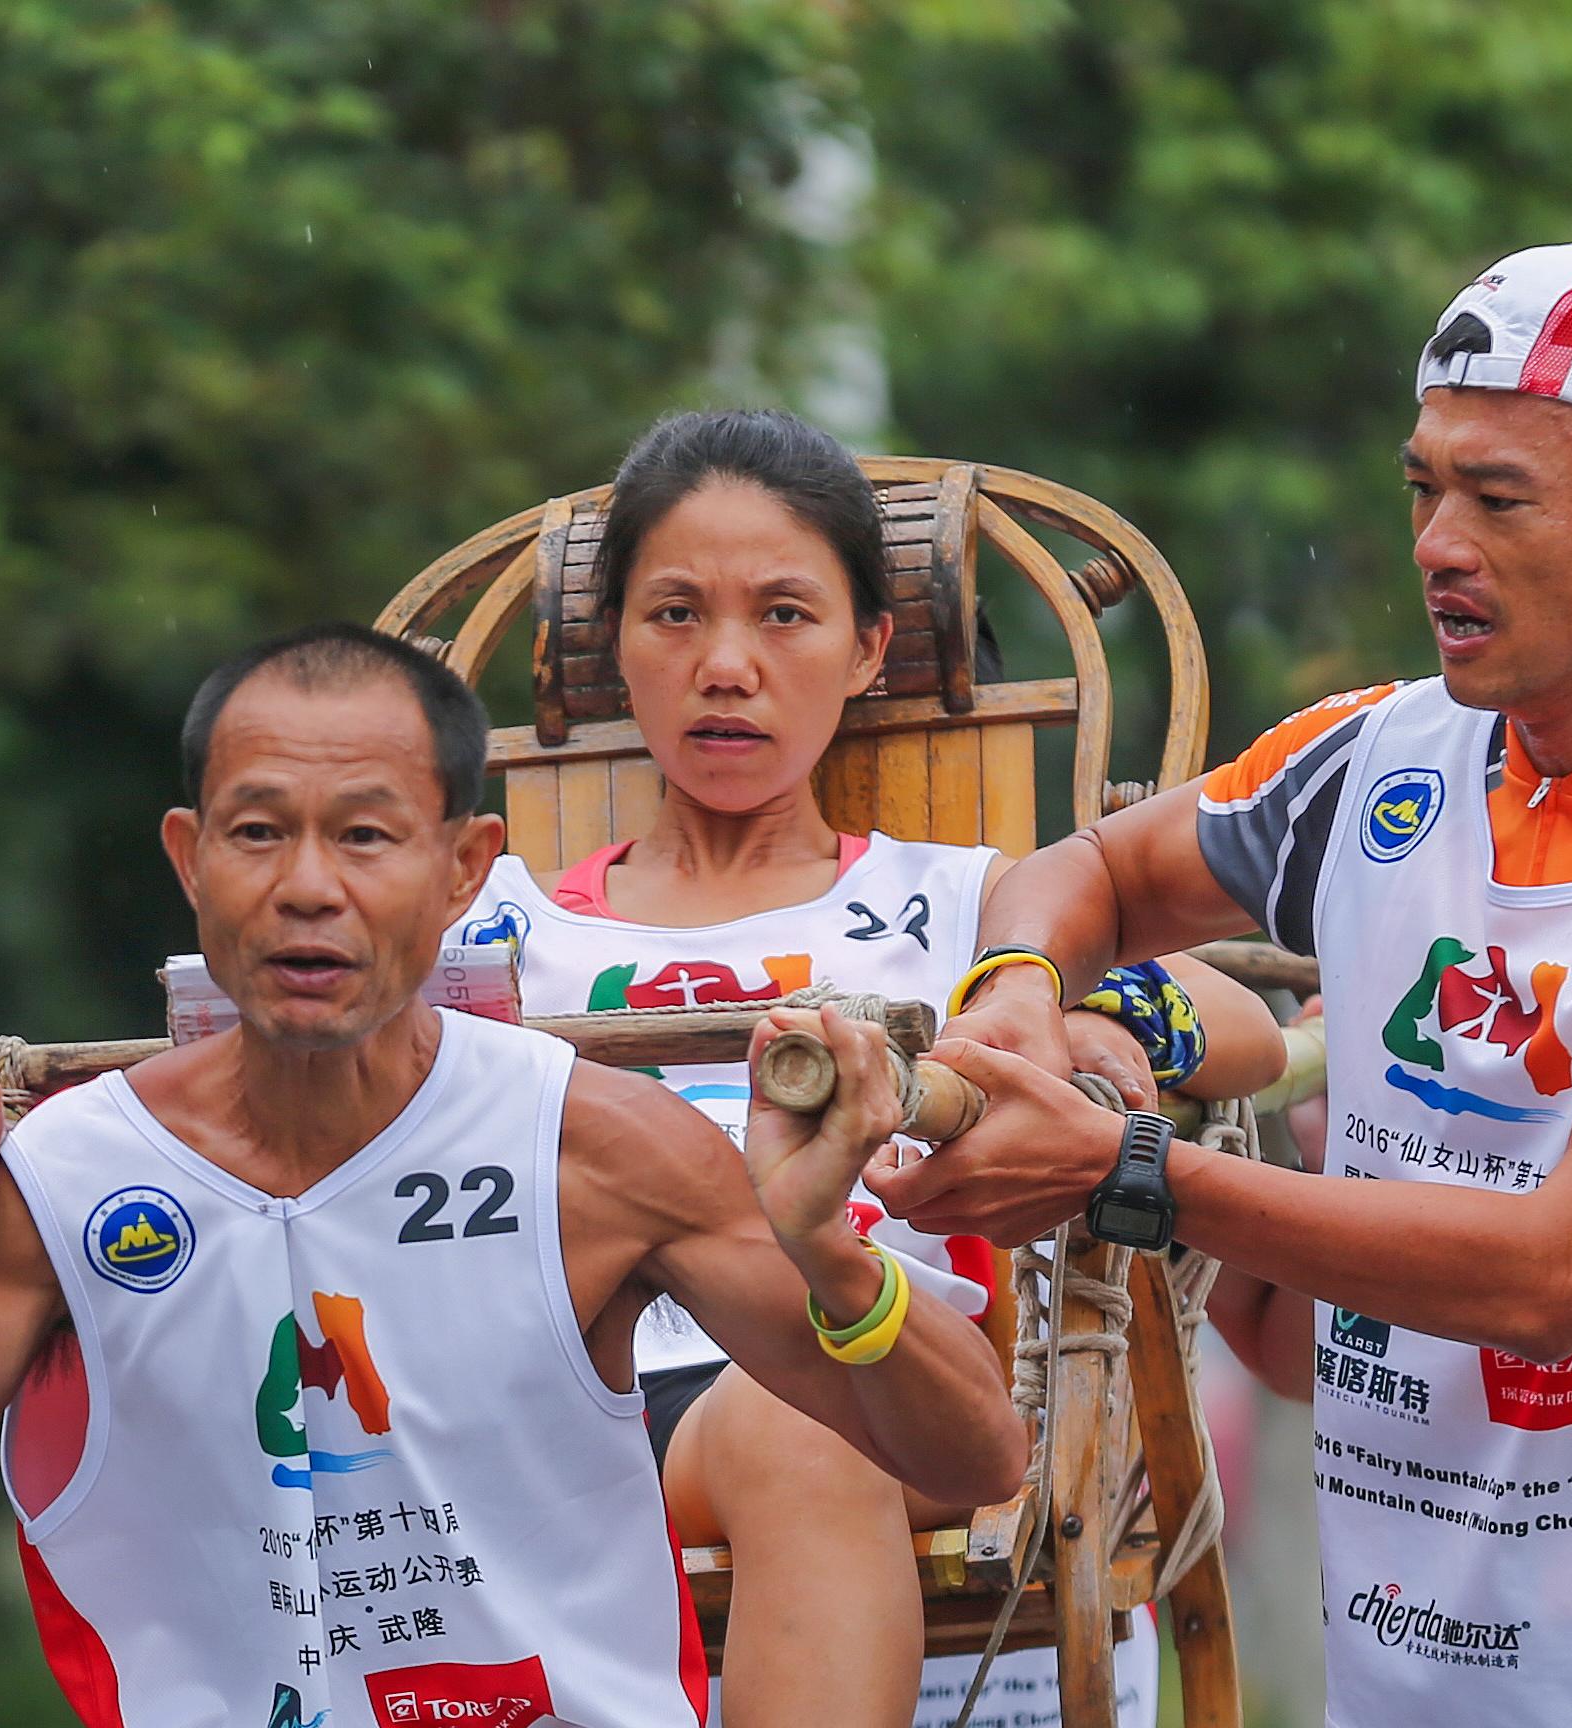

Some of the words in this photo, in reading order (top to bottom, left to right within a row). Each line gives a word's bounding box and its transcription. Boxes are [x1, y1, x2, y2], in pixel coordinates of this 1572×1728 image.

[443, 947, 472, 1011] 605
[394, 1166, 519, 1244] 22
[1334, 1330, 1383, 1354] KARST
[1329, 1476, 1416, 1513] Mountain
[1420, 1499, 1469, 1527] Quest
[1522, 1481, 1560, 1498] the
